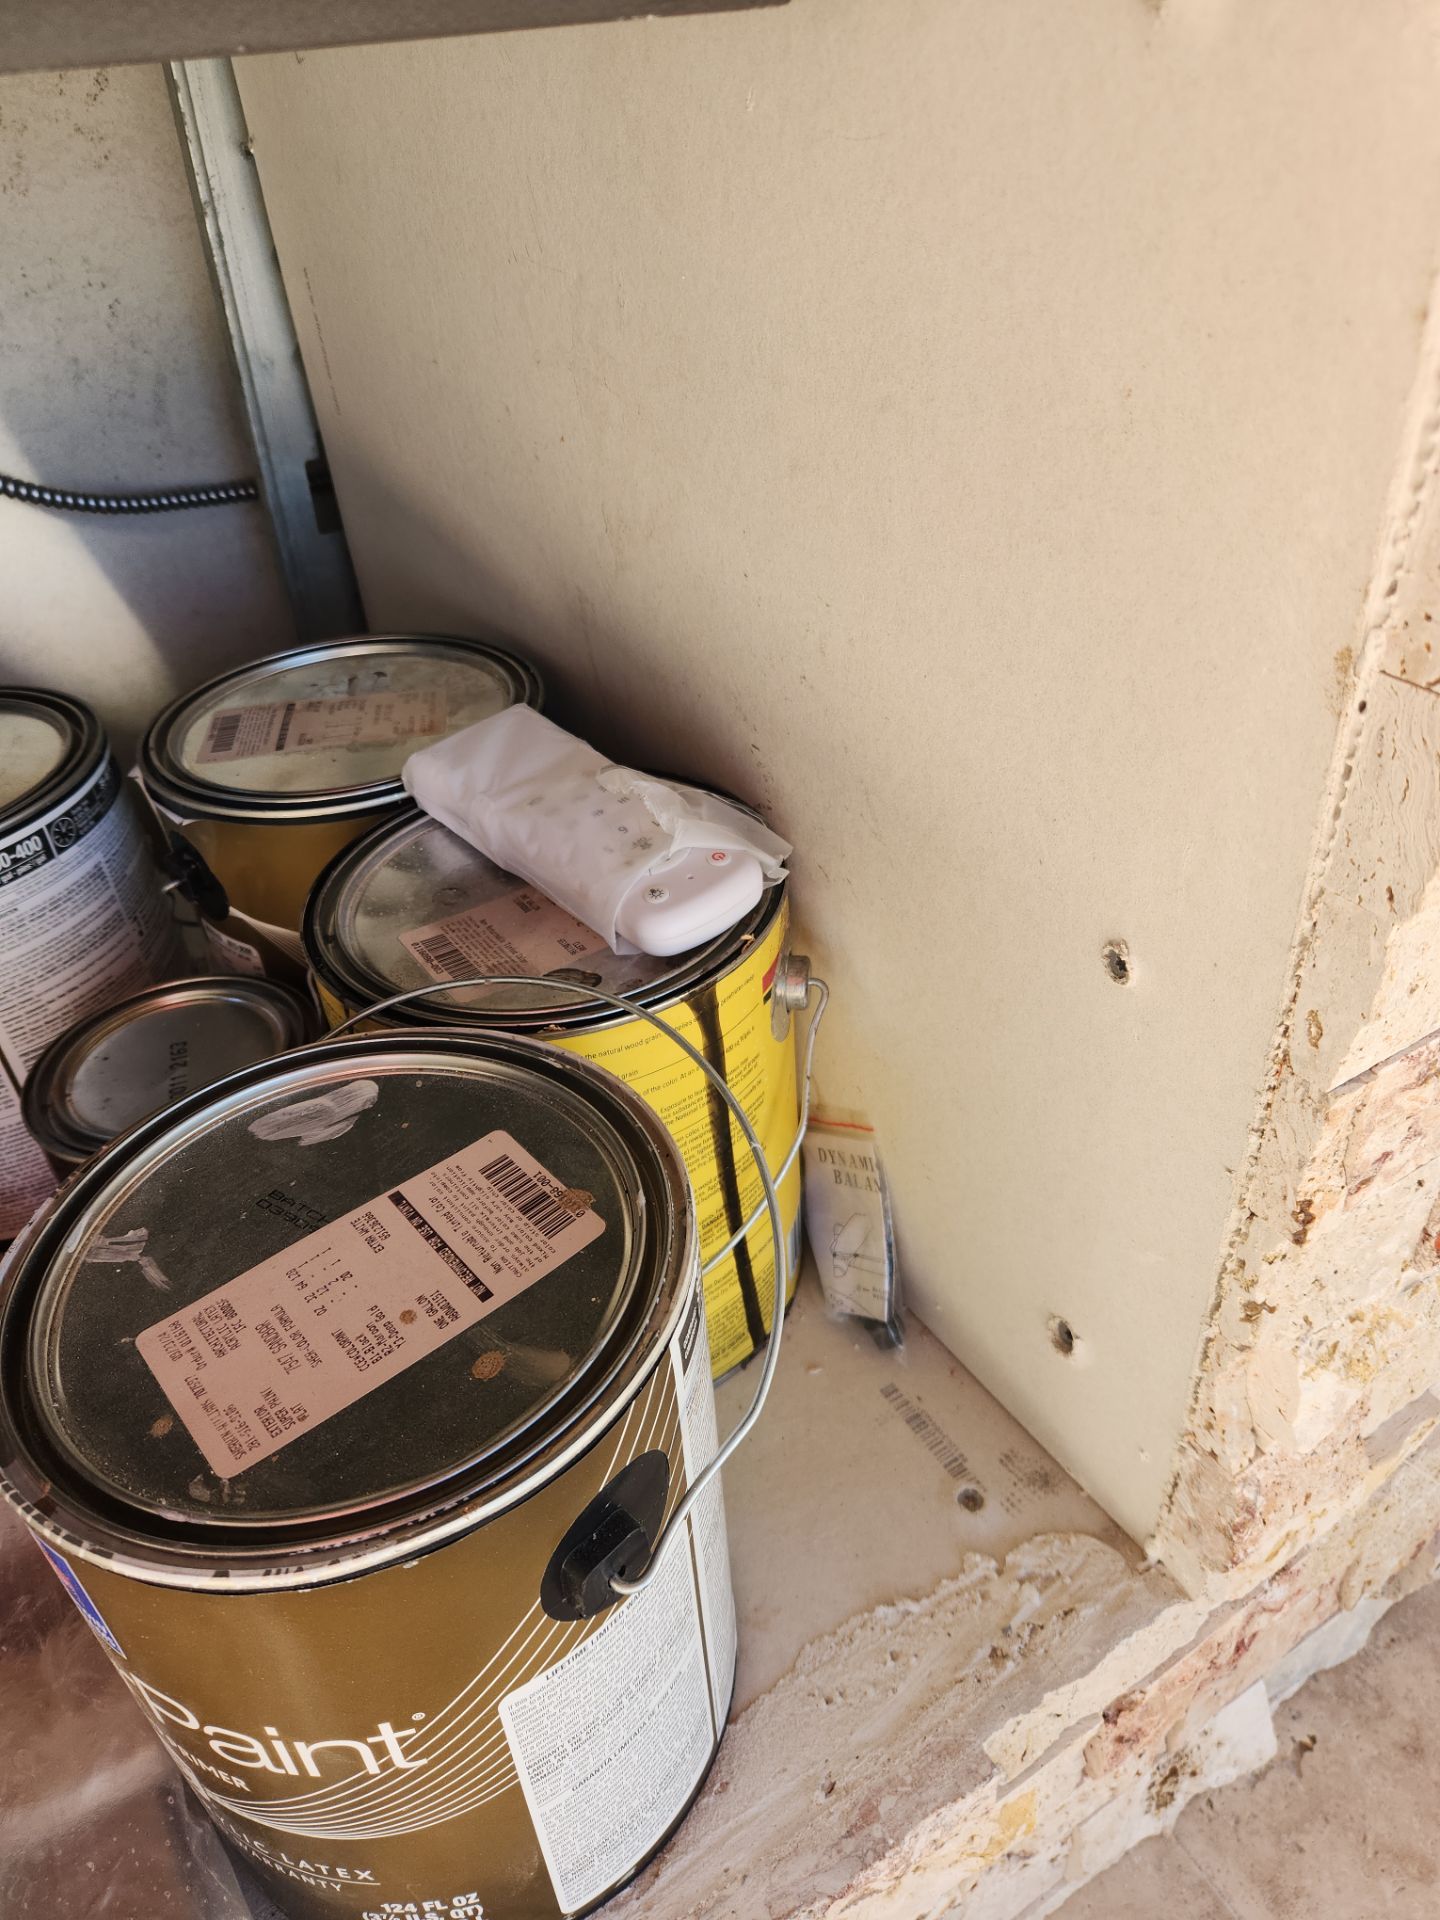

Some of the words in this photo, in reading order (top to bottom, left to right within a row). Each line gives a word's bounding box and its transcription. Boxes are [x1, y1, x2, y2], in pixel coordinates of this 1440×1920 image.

[0, 835, 43, 871] 0-400
[598, 1045, 623, 1058] natural
[624, 1039, 644, 1050] wood
[621, 1070, 639, 1080] grain
[660, 1097, 688, 1114] Exposure
[817, 1147, 876, 1173] DYNAMI
[428, 1195, 445, 1213] Color
[529, 1169, 587, 1219] 0168-001
[349, 1217, 370, 1236] WHITE
[417, 1224, 433, 1238] USE
[440, 1210, 463, 1232] Tinted
[364, 1234, 385, 1254] EXTRA
[426, 1235, 444, 1249] FOR
[460, 1229, 493, 1263] Returnable
[531, 1242, 549, 1259] Mixed
[436, 1246, 476, 1284] RECOMMENDED
[489, 1260, 504, 1275] Non
[315, 1284, 329, 1296] 12
[469, 1280, 487, 1296] NOT
[366, 1304, 386, 1323] Gold
[414, 1293, 439, 1317] GALLON
[269, 1303, 296, 1332] FORMULA
[432, 1314, 449, 1329] ONE
[215, 1322, 241, 1351] ACRYLIC
[253, 1319, 287, 1354] SANDBAR
[365, 1321, 395, 1357] R2-Maroon
[382, 1320, 406, 1349] Y3-Deep
[288, 1329, 323, 1368] SHER-COLOR
[276, 1351, 301, 1375] 7547
[253, 1403, 283, 1439] EXTERIOR
[273, 1406, 296, 1430] SUPER
[280, 1853, 375, 1881] LATEX
[380, 1903, 417, 1914] 124
[422, 1900, 449, 1912] FL
[452, 1892, 480, 1907] OZ
